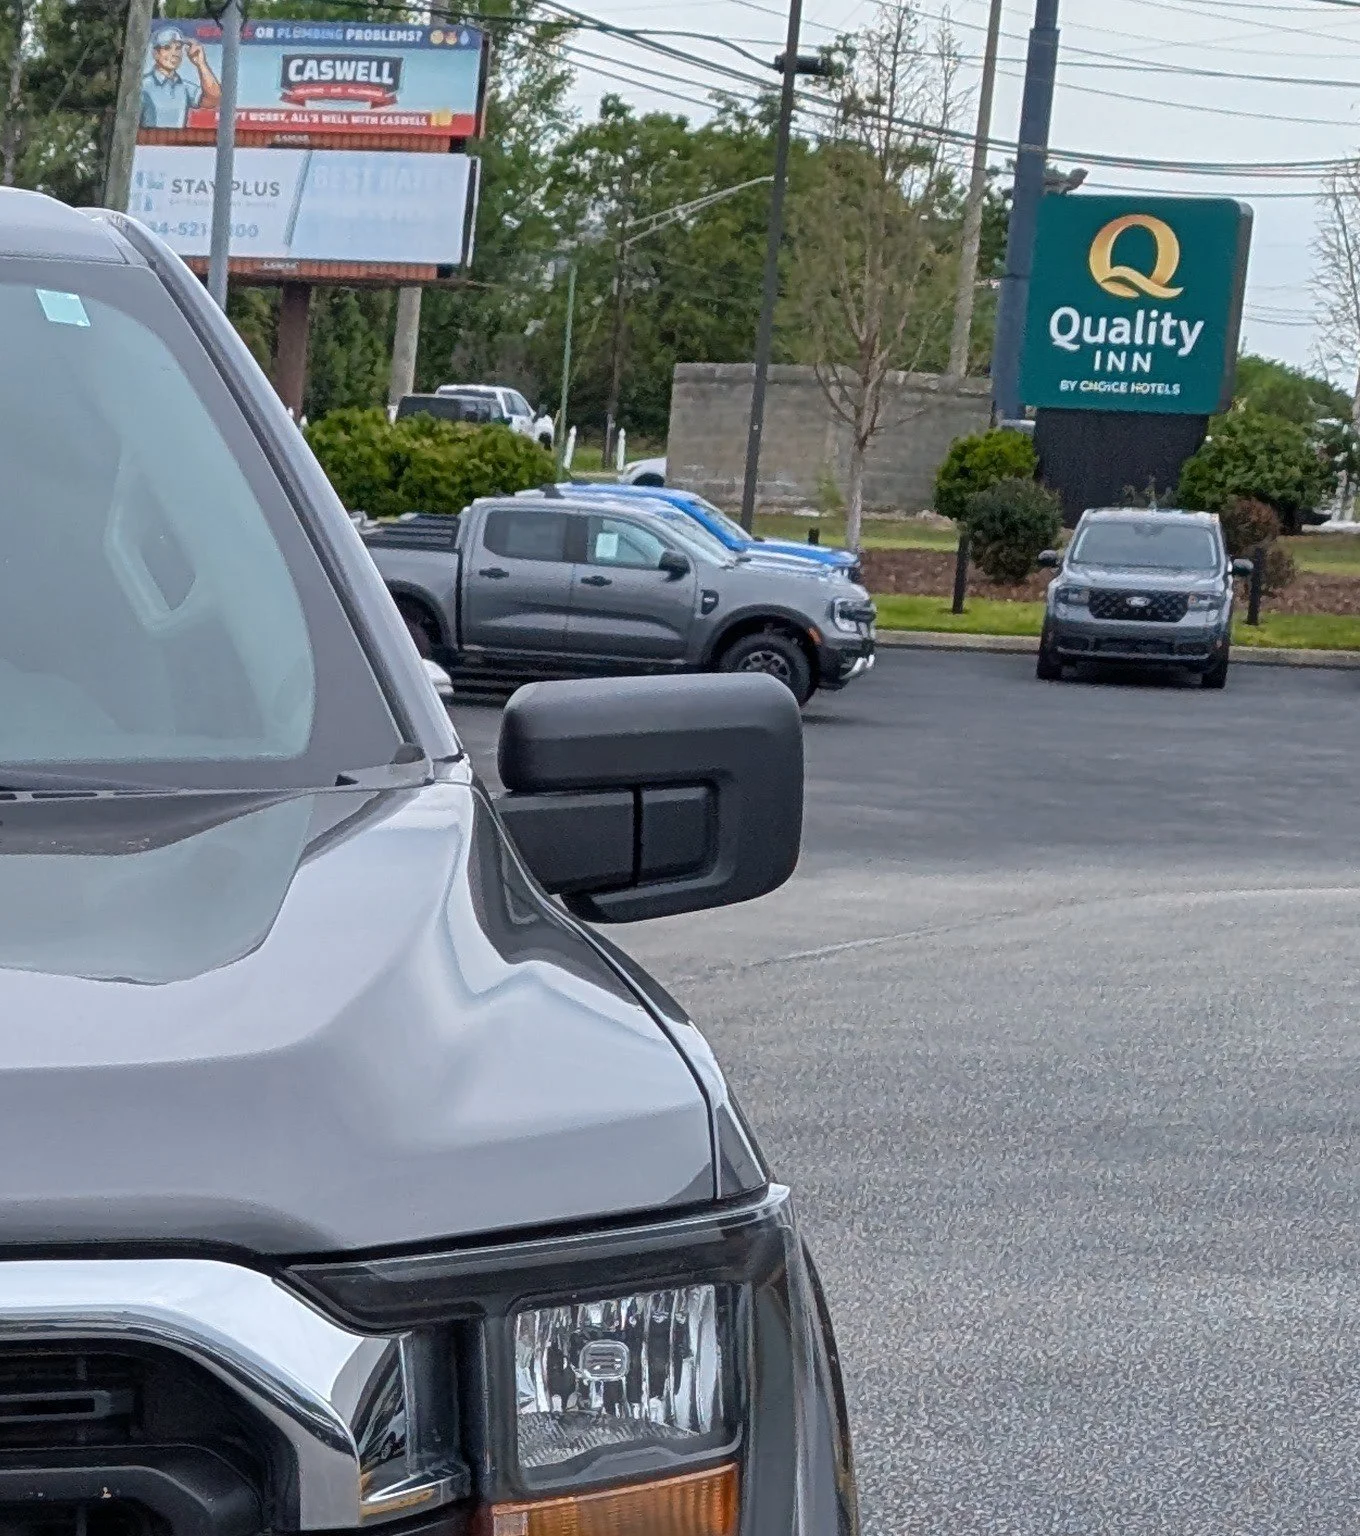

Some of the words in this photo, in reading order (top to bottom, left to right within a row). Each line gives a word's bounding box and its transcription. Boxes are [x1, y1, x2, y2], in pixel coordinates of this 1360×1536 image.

[345, 28, 423, 42] PROBLEMS?
[288, 58, 394, 84] CASWELL
[1049, 306, 1205, 356] Quality
[1093, 350, 1152, 373] INN
[1060, 380, 1078, 392] BY
[1080, 380, 1128, 394] CHOICE
[1130, 381, 1181, 396] HOTELS
